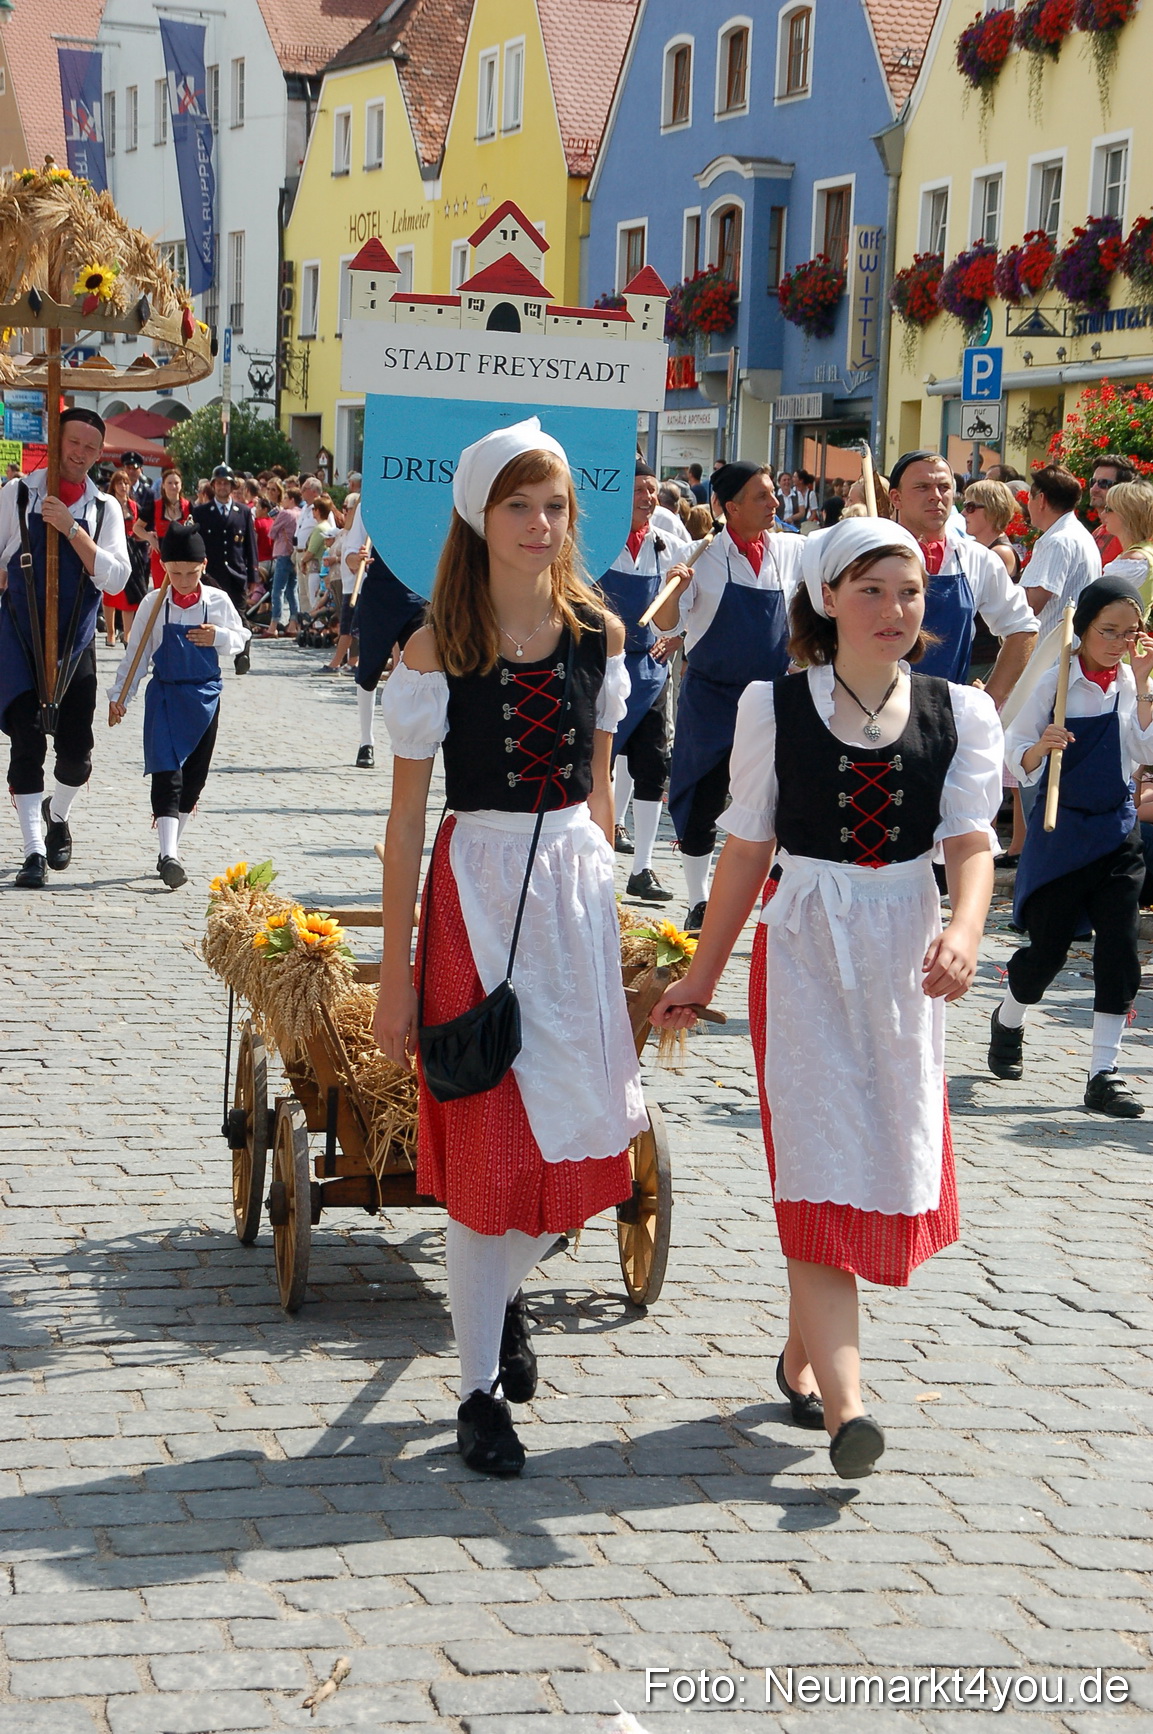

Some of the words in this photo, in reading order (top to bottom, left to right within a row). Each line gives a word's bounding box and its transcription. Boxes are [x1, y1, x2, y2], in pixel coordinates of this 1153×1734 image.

[349, 210, 383, 244] HOTEL
[392, 206, 431, 234] Lehmeier
[858, 229, 881, 250] CAFÉ
[858, 253, 878, 359] WITTL
[384, 347, 471, 373] STADT
[477, 354, 630, 384] FREYSTADT
[971, 354, 994, 396] P
